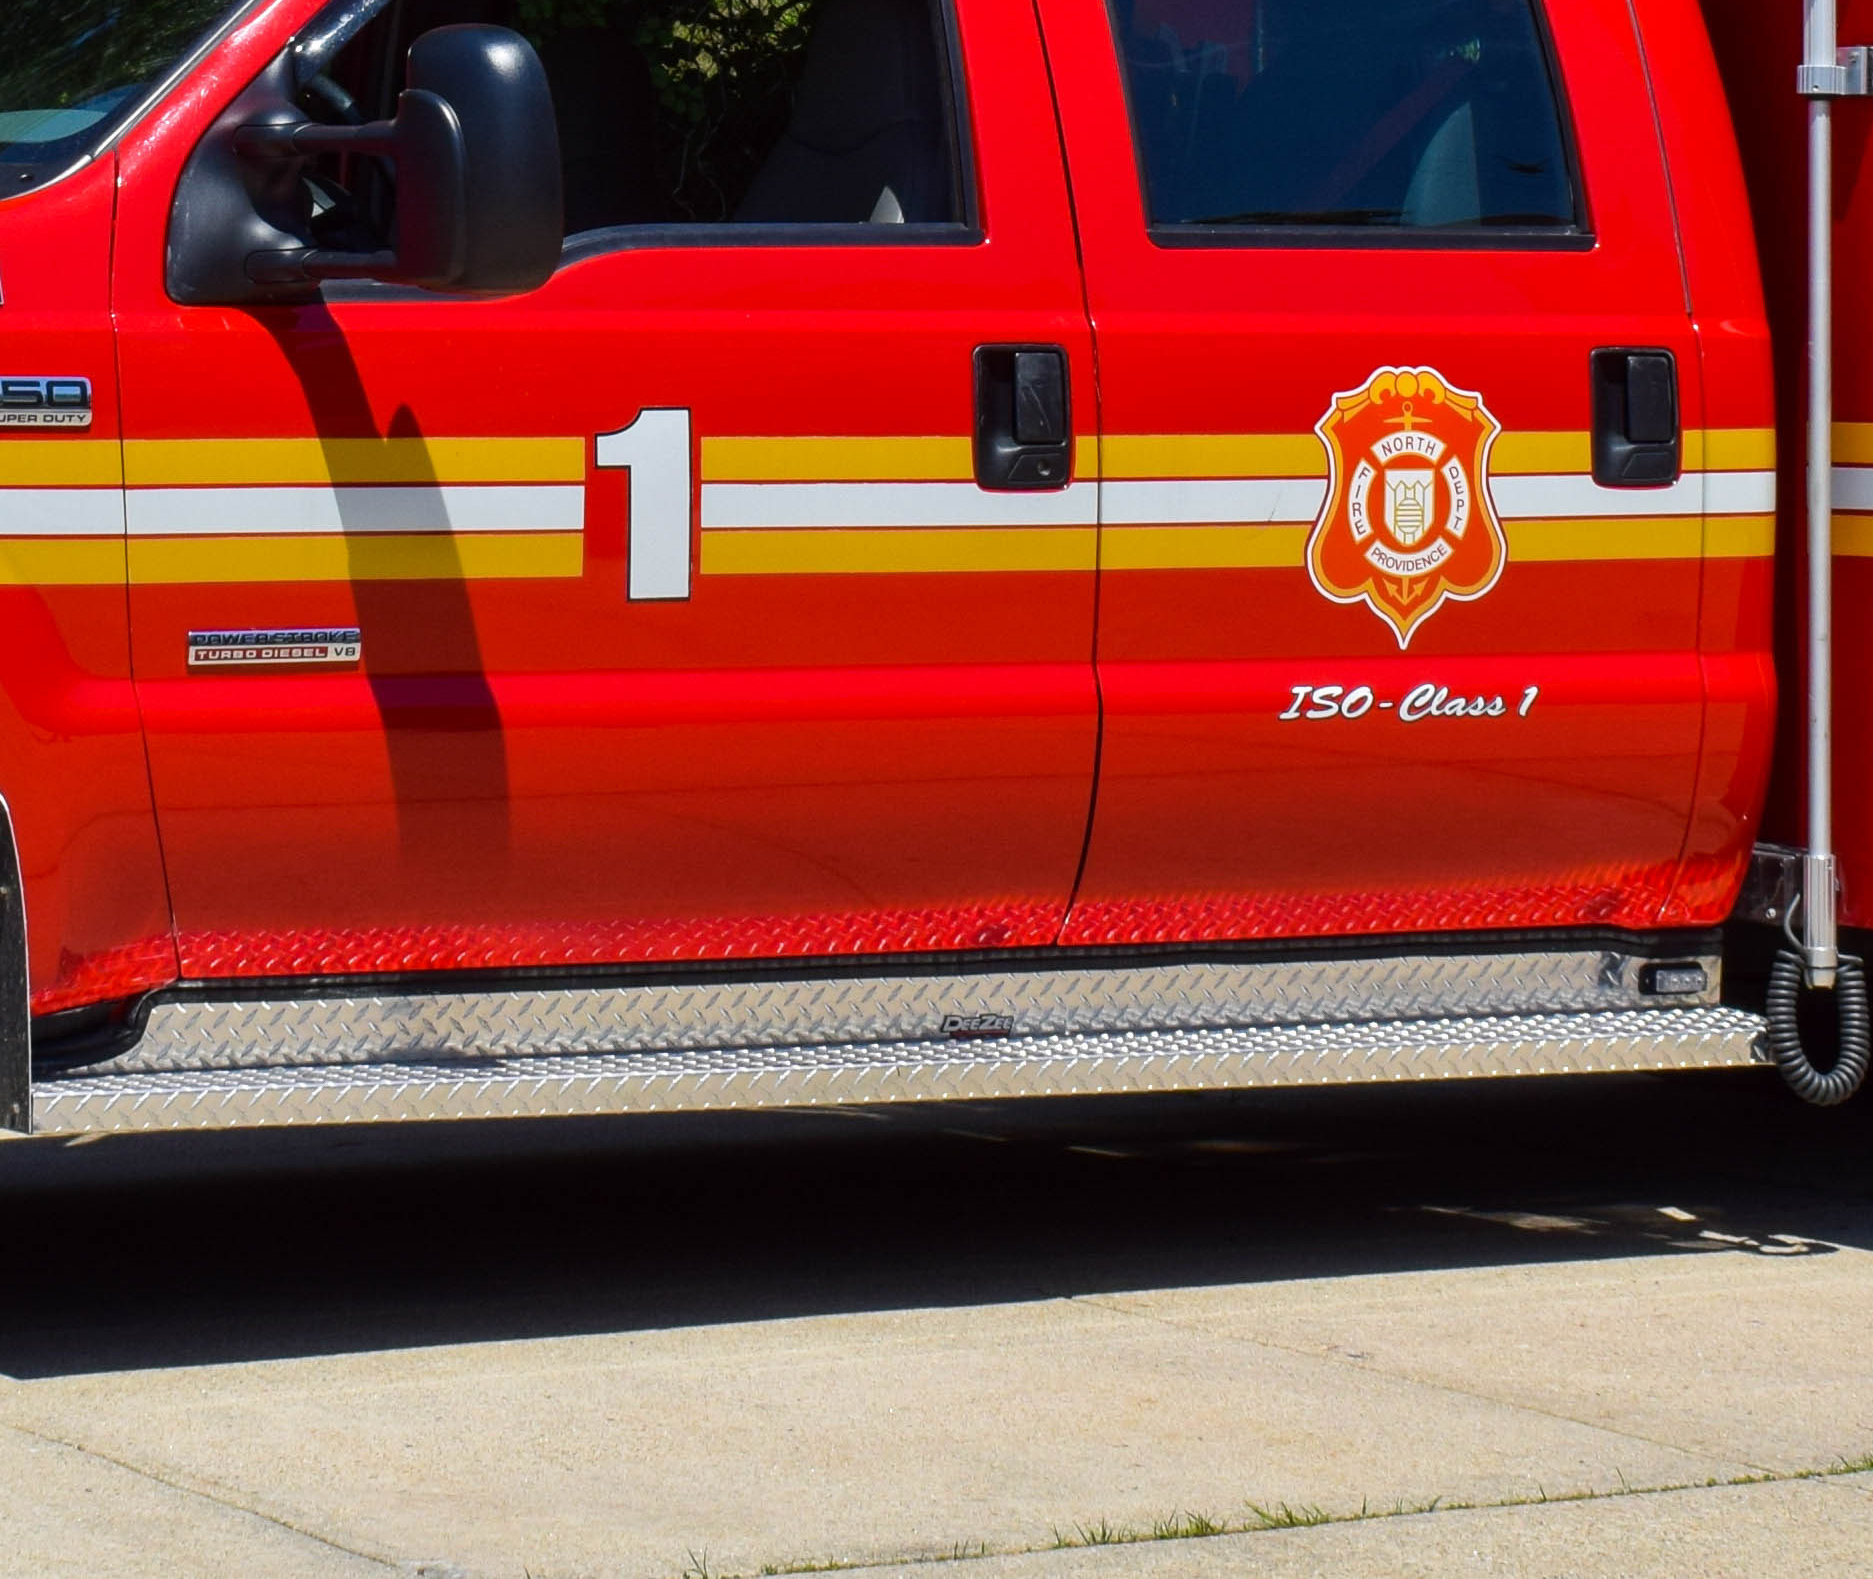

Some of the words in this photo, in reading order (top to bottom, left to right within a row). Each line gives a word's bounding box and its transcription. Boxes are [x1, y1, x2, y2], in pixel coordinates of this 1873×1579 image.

[42, 414, 87, 424] DUTY
[1381, 435, 1436, 457] NORTH
[594, 407, 692, 603] 1
[1352, 467, 1371, 536] FIRE
[1448, 466, 1465, 530] DEPT
[1370, 543, 1448, 572] PROVIDENCE
[197, 649, 257, 660] TURBO
[261, 647, 326, 658] DIESEL
[333, 646, 356, 656] V8
[1518, 685, 1539, 717] 1
